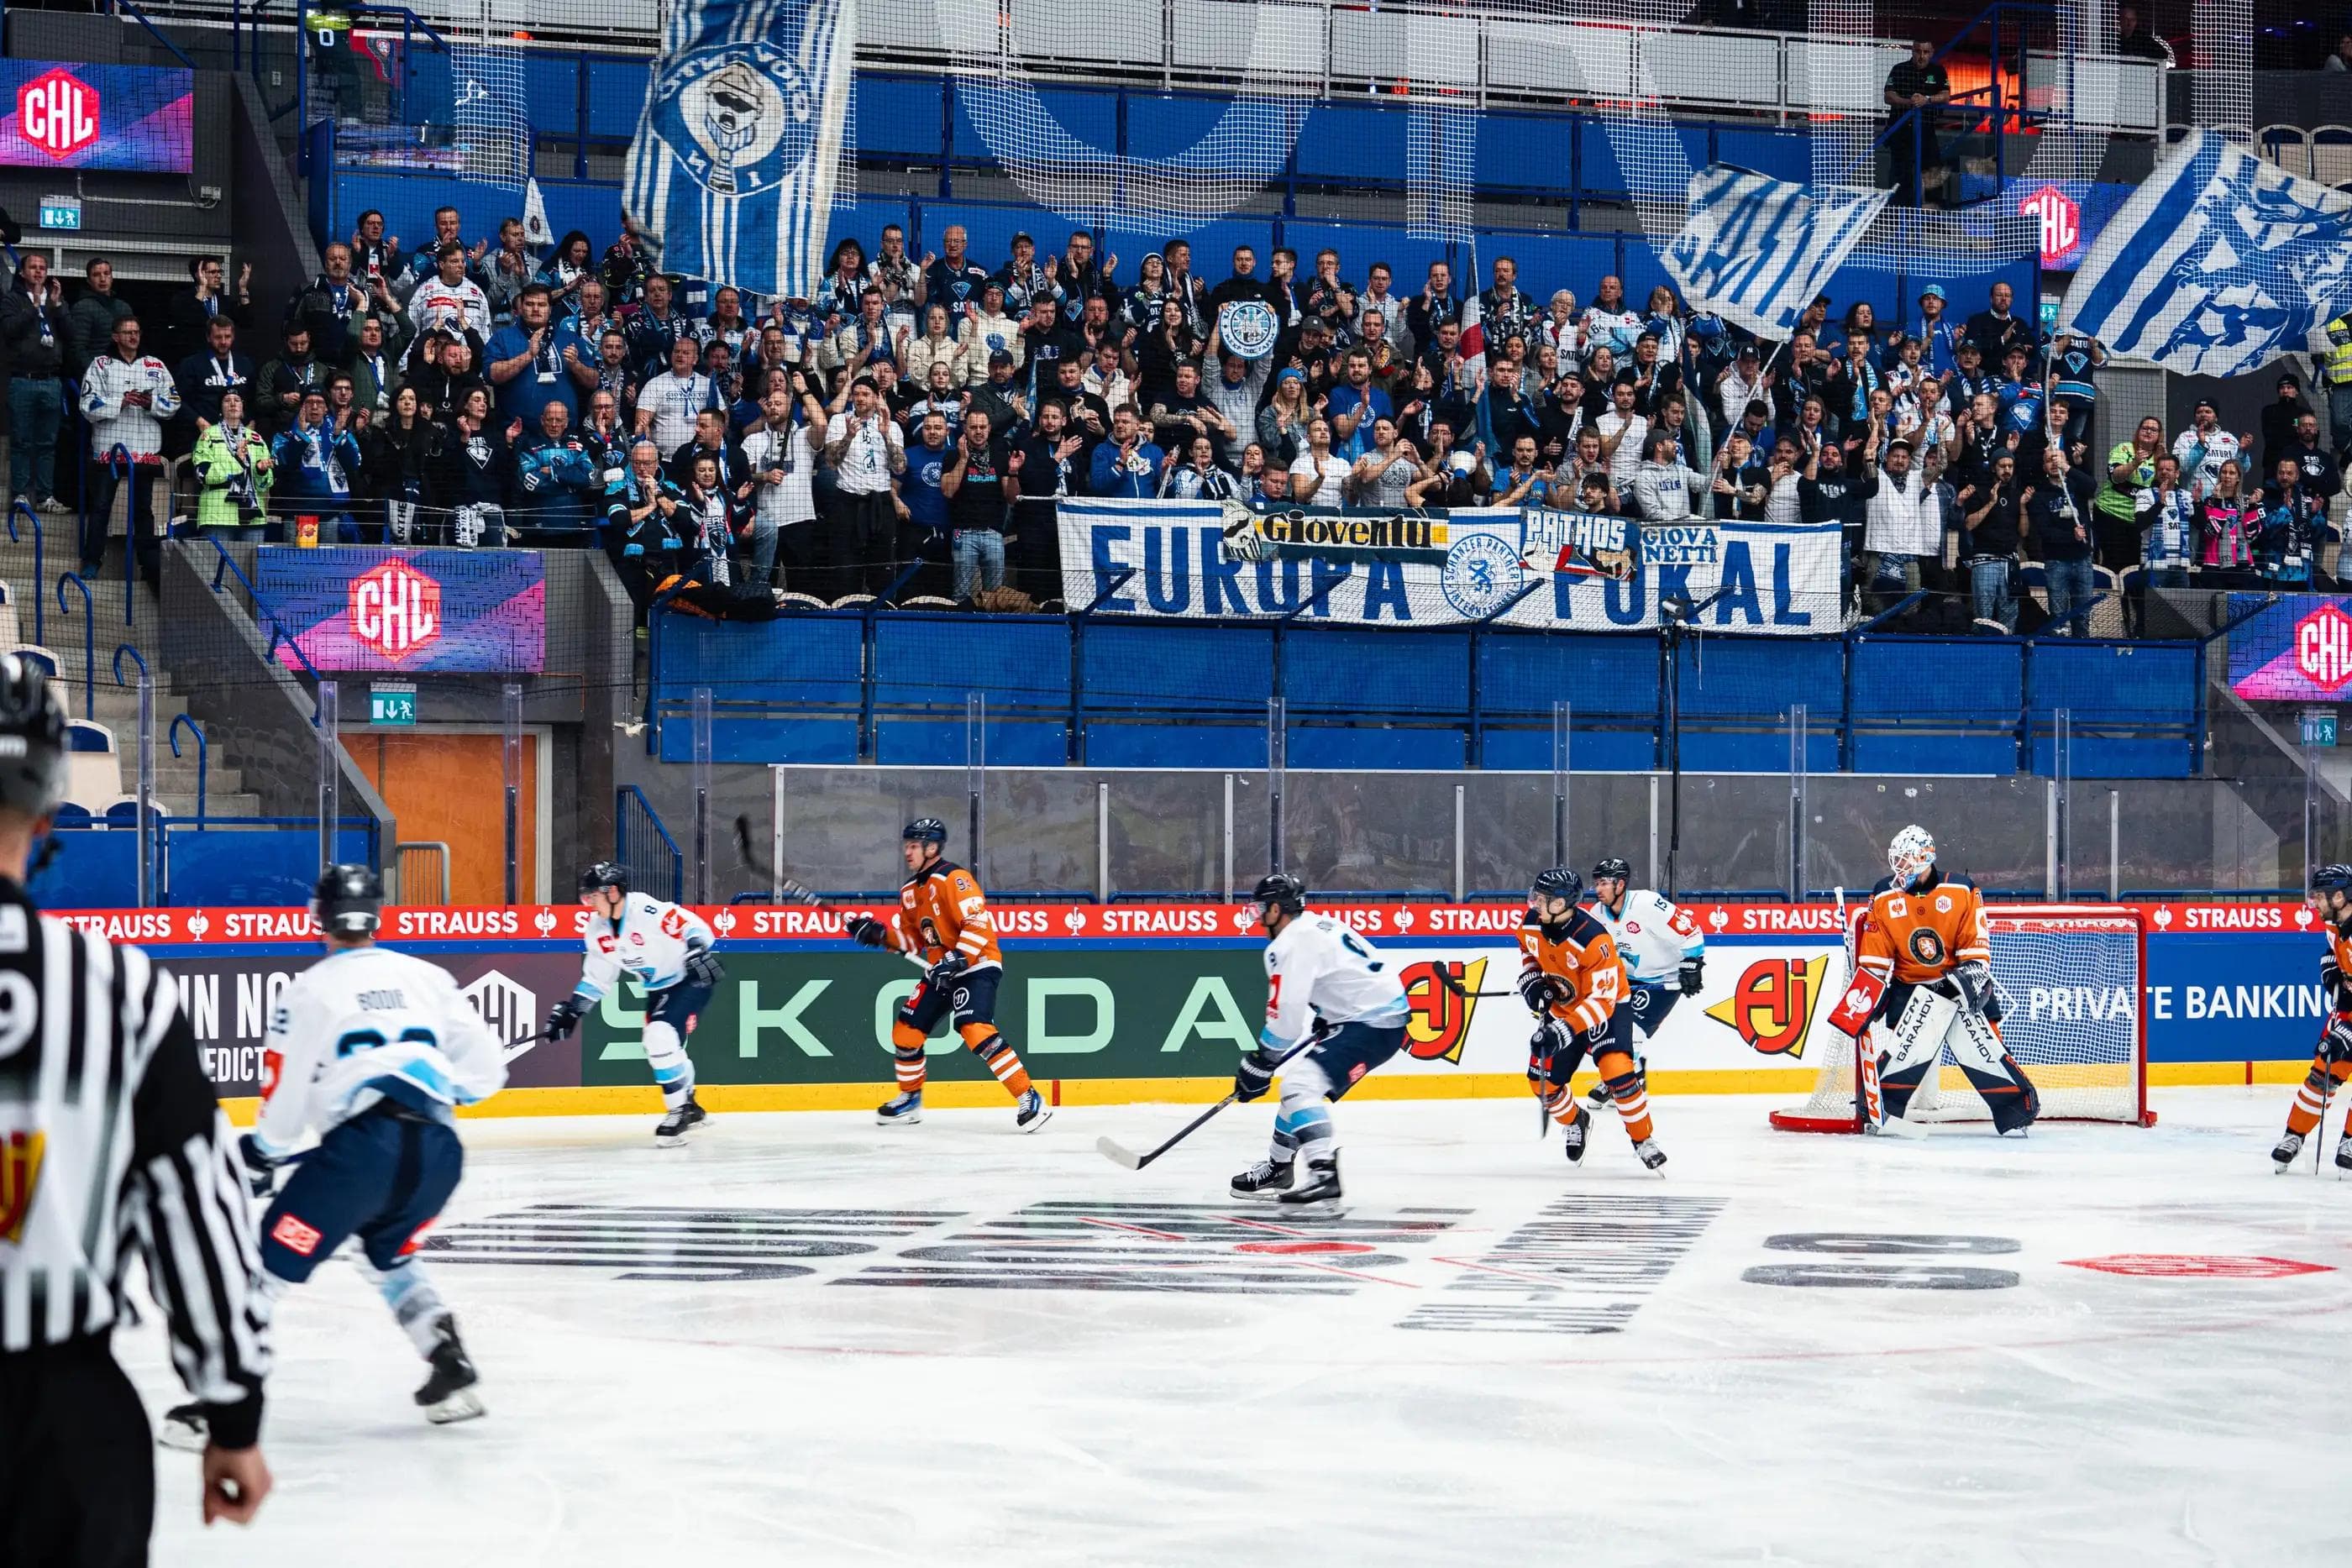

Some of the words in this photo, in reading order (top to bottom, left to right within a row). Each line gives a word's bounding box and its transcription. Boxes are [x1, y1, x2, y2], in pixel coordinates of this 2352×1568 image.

[24, 81, 94, 148] CHL
[2071, 338, 2088, 349] SATU
[1526, 510, 1626, 555] PATHOS
[1642, 527, 1718, 546] GIOVA
[1445, 538, 1482, 581] SCHANZER
[1486, 538, 1520, 579] PANTHER
[1645, 546, 1718, 564] NETTI
[357, 570, 433, 649] CHL
[398, 911, 518, 935] STRAUSS
[1103, 910, 1218, 932] STRAUSS
[1430, 910, 1522, 931] STRAUS
[1743, 910, 1845, 930] STRAUSS
[2186, 908, 2282, 928] STRAUSS
[179, 973, 219, 1040] IN
[466, 983, 528, 1050] HL
[1896, 996, 1919, 1038] CCM
[1974, 1012, 1993, 1041] CM
[207, 1046, 268, 1083] EDICT
[1860, 1030, 1881, 1120] CCM
